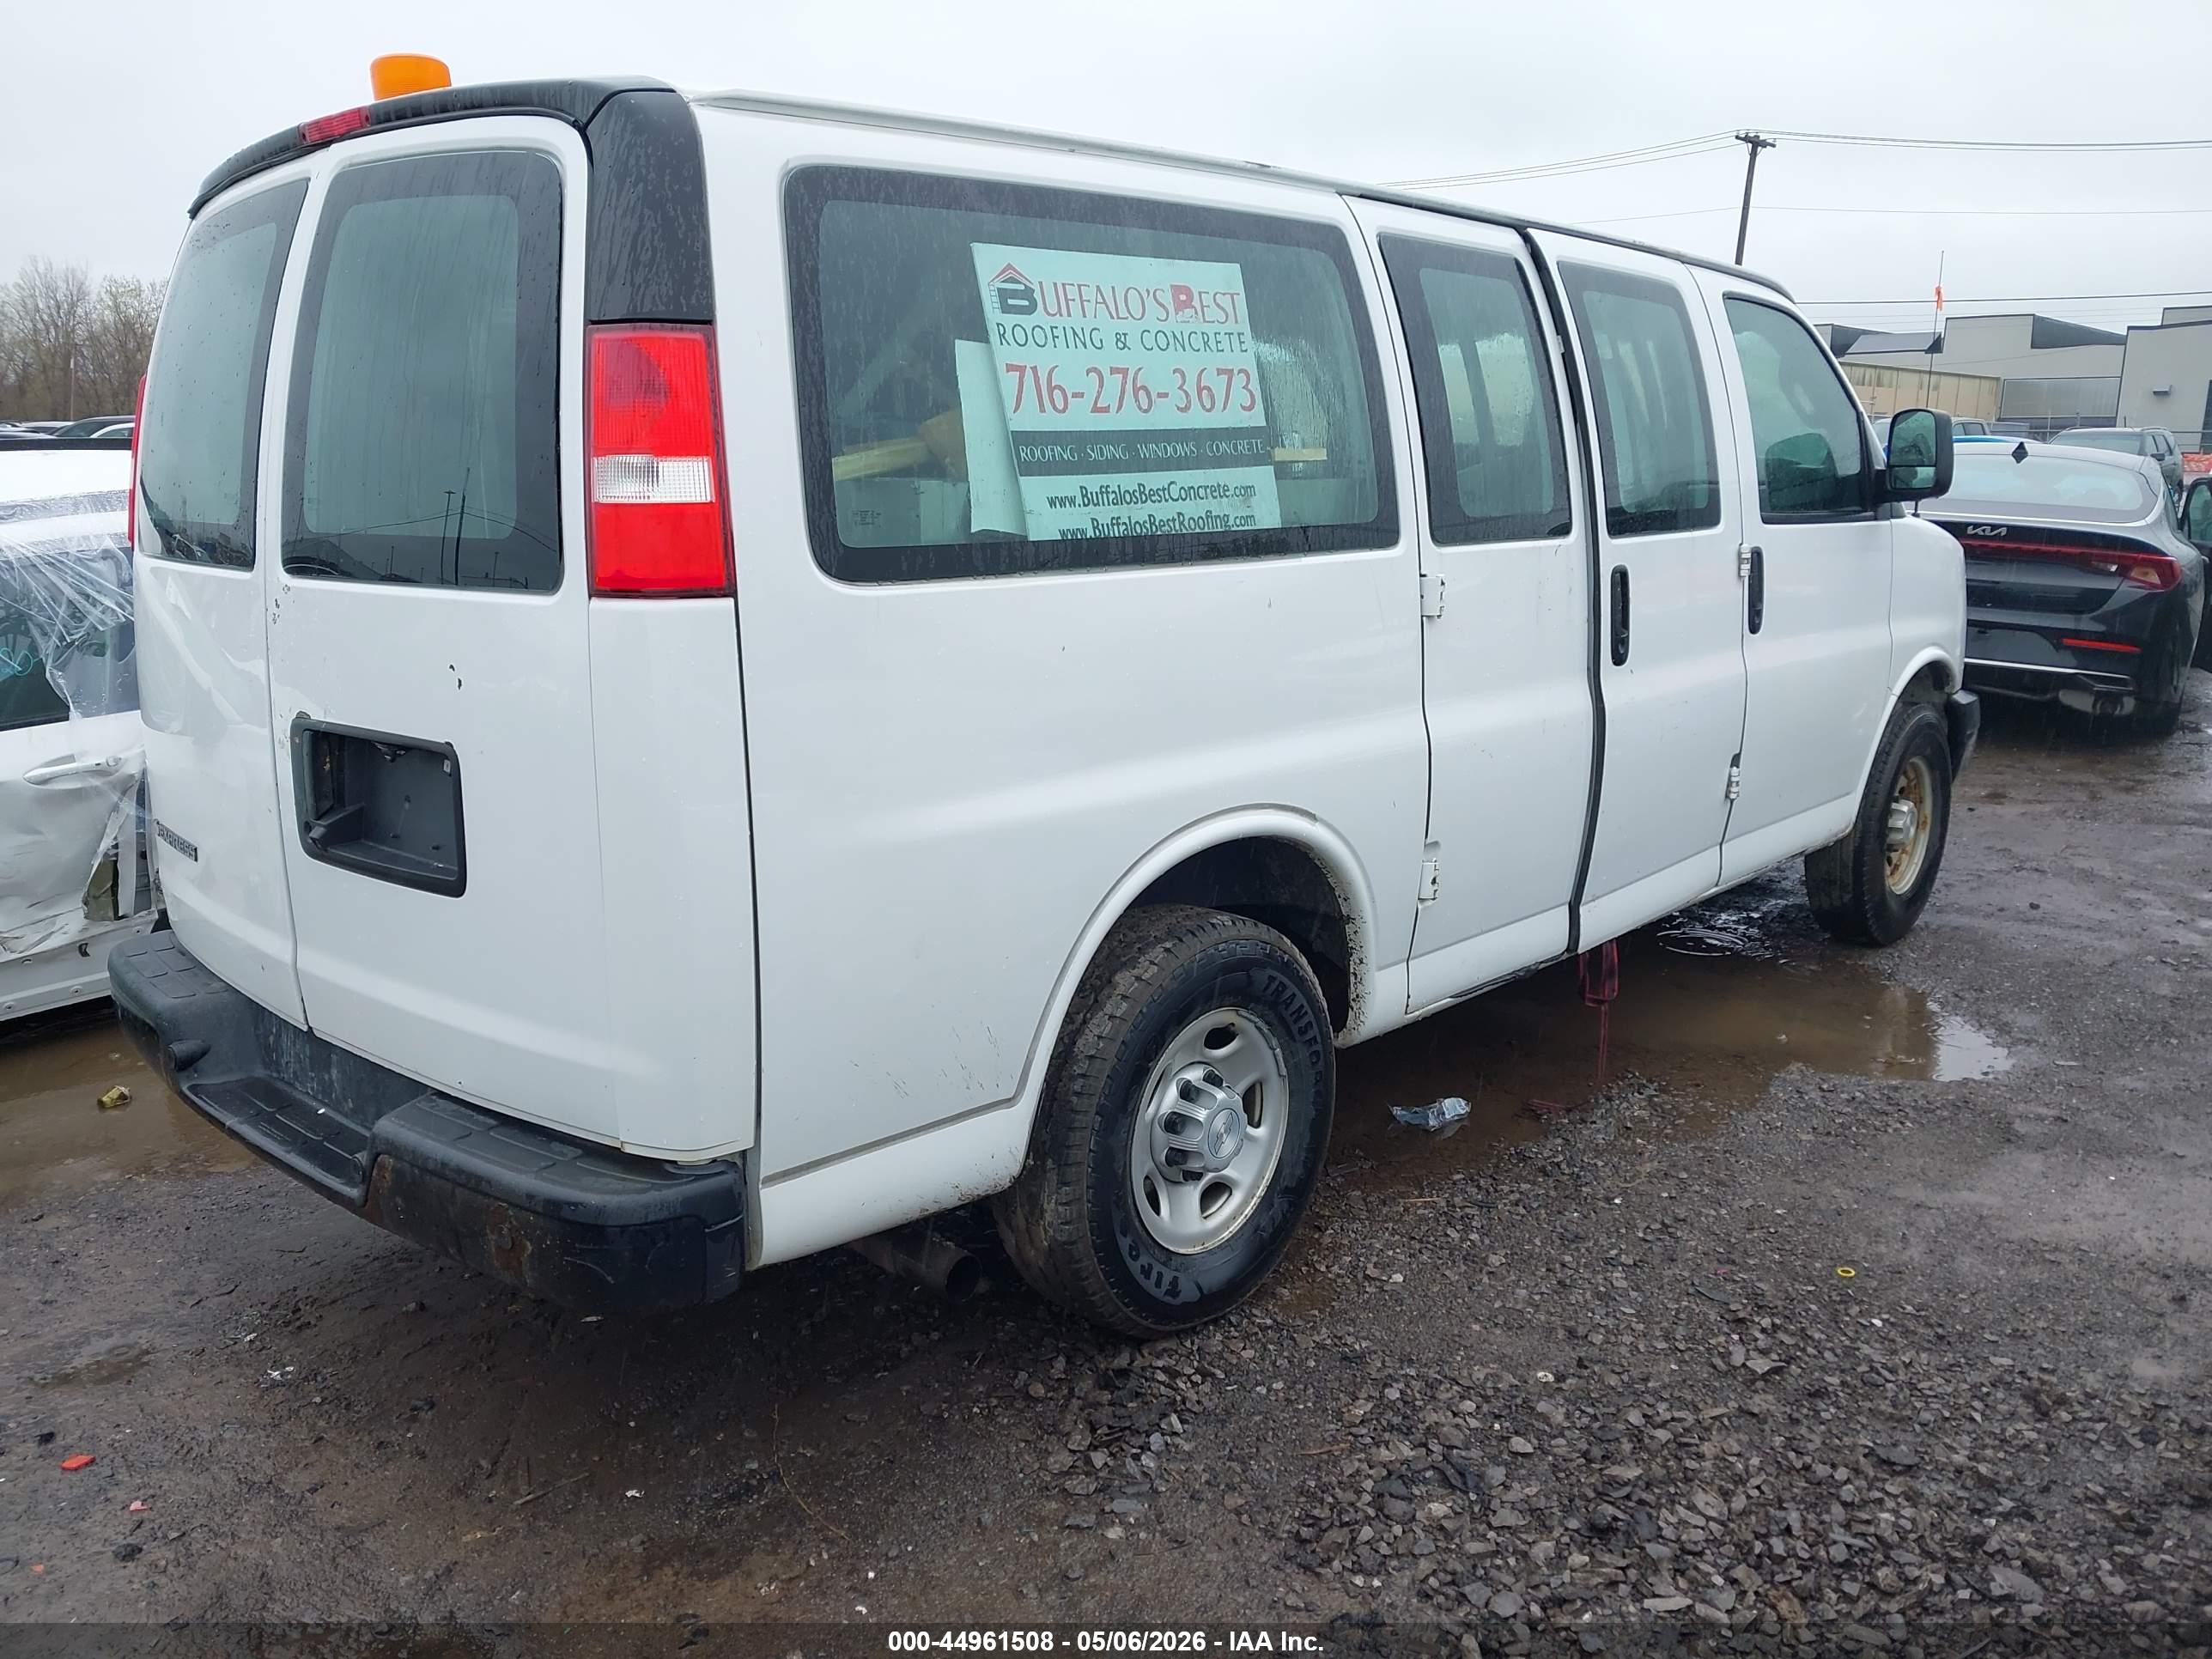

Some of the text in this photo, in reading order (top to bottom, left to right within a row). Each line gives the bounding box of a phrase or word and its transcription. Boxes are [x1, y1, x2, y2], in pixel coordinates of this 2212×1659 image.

[989, 273, 1240, 325] BUFFALO'S BEST
[996, 322, 1248, 353] ROOFING & CONCRETE
[1006, 362, 1256, 414] 716-276-3673
[1019, 439, 1265, 462] ROOFING SIDING WINDOWS CONCRETE
[1046, 480, 1256, 509] www.BuffalosBestConcrete.com
